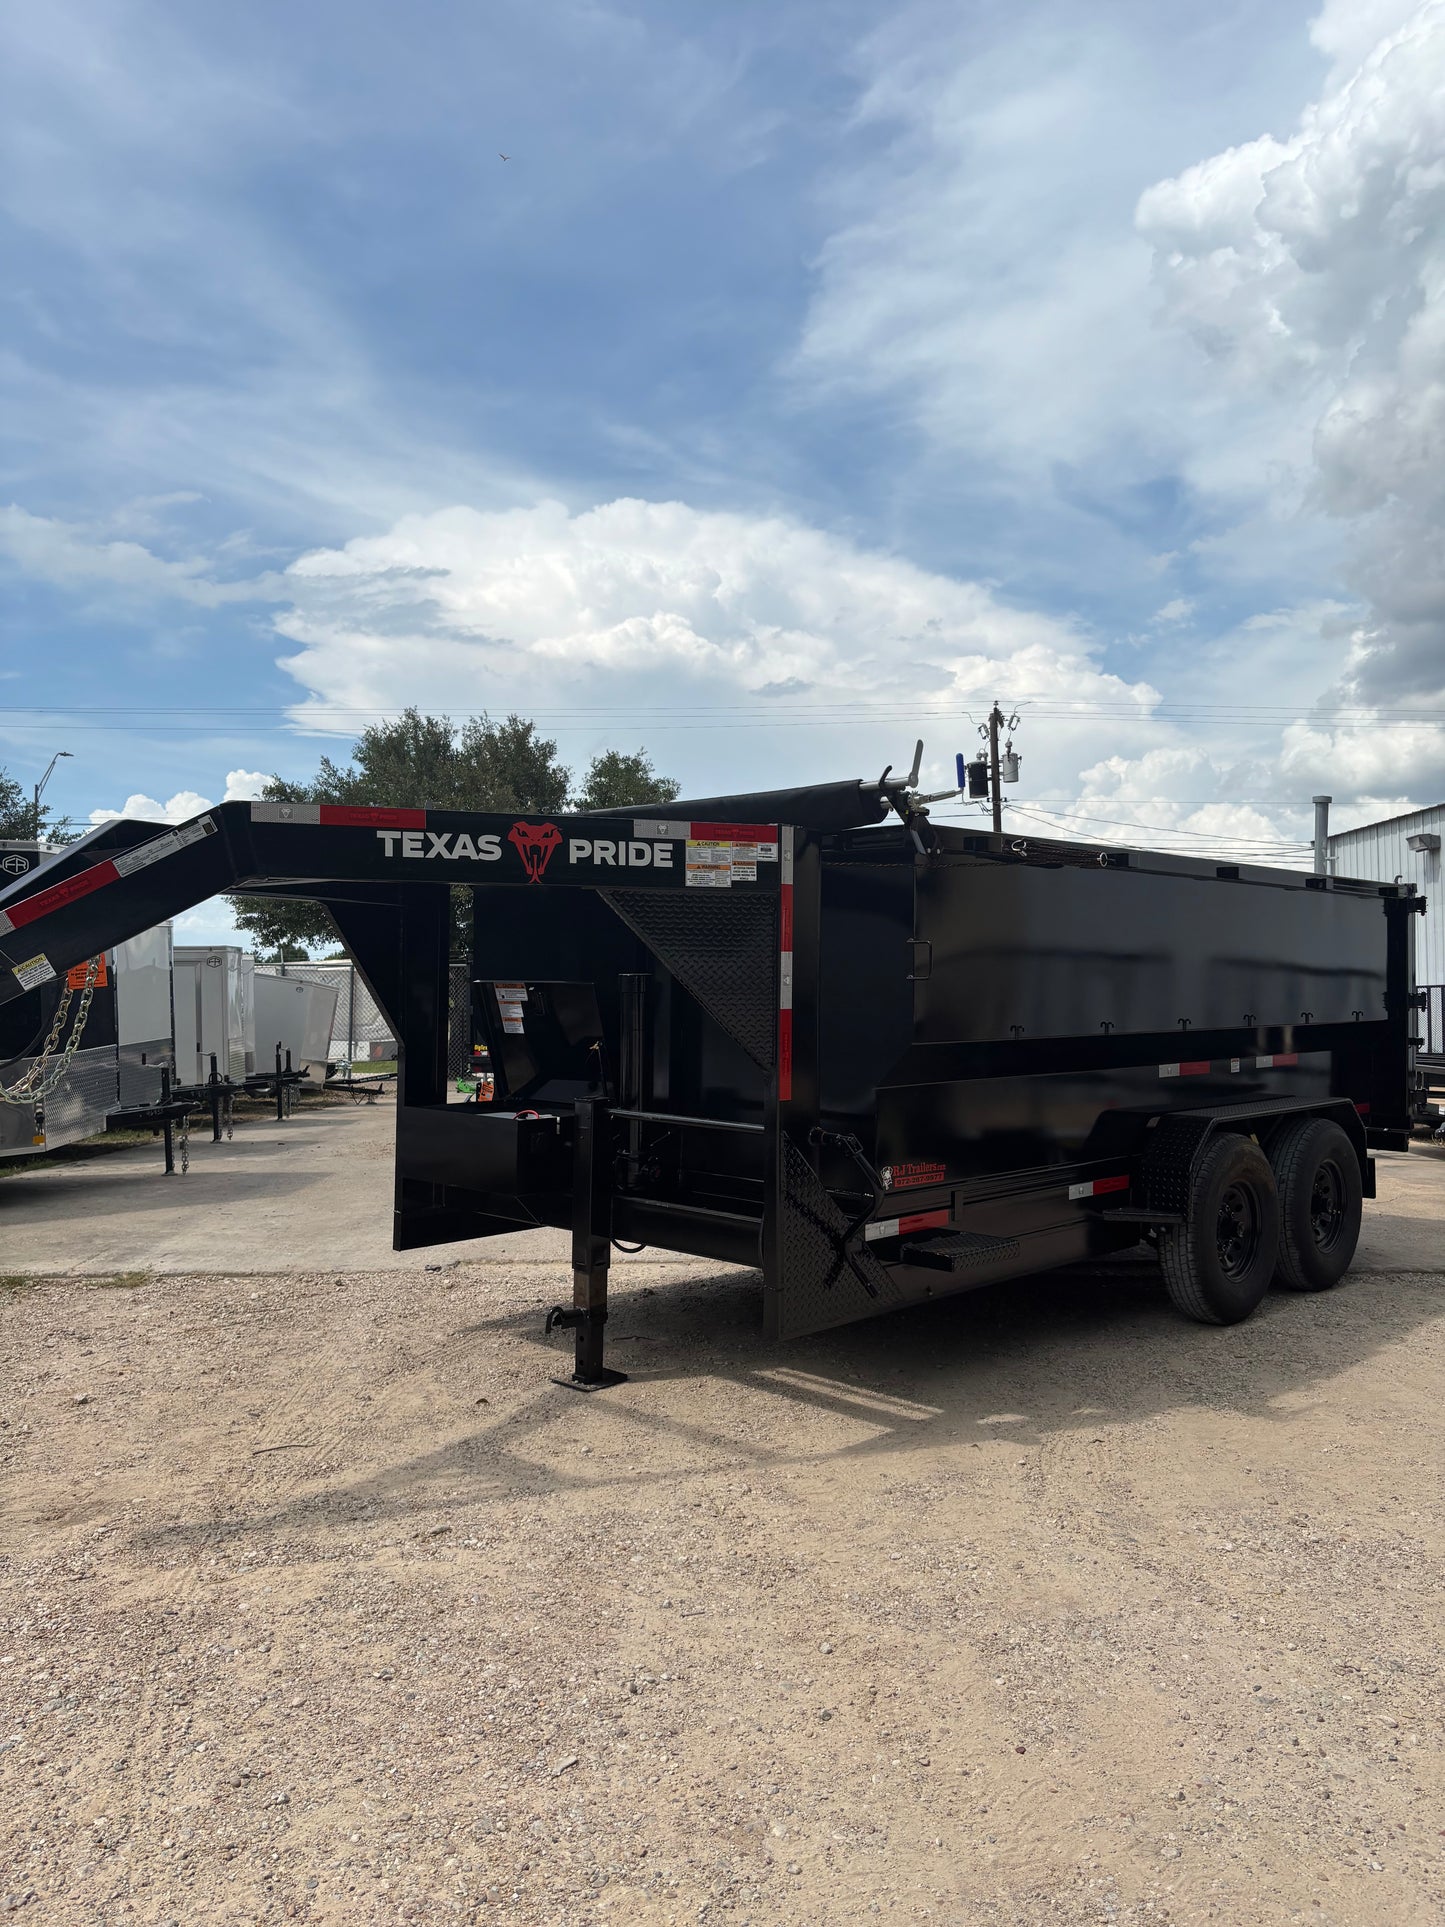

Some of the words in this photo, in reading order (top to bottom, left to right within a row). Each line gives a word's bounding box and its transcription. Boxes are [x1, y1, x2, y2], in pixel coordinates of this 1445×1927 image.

[376, 830, 503, 861] TEXAS
[569, 839, 674, 868] PRIDE
[21, 956, 43, 970] CAUTION
[892, 1165, 906, 1177] RJ
